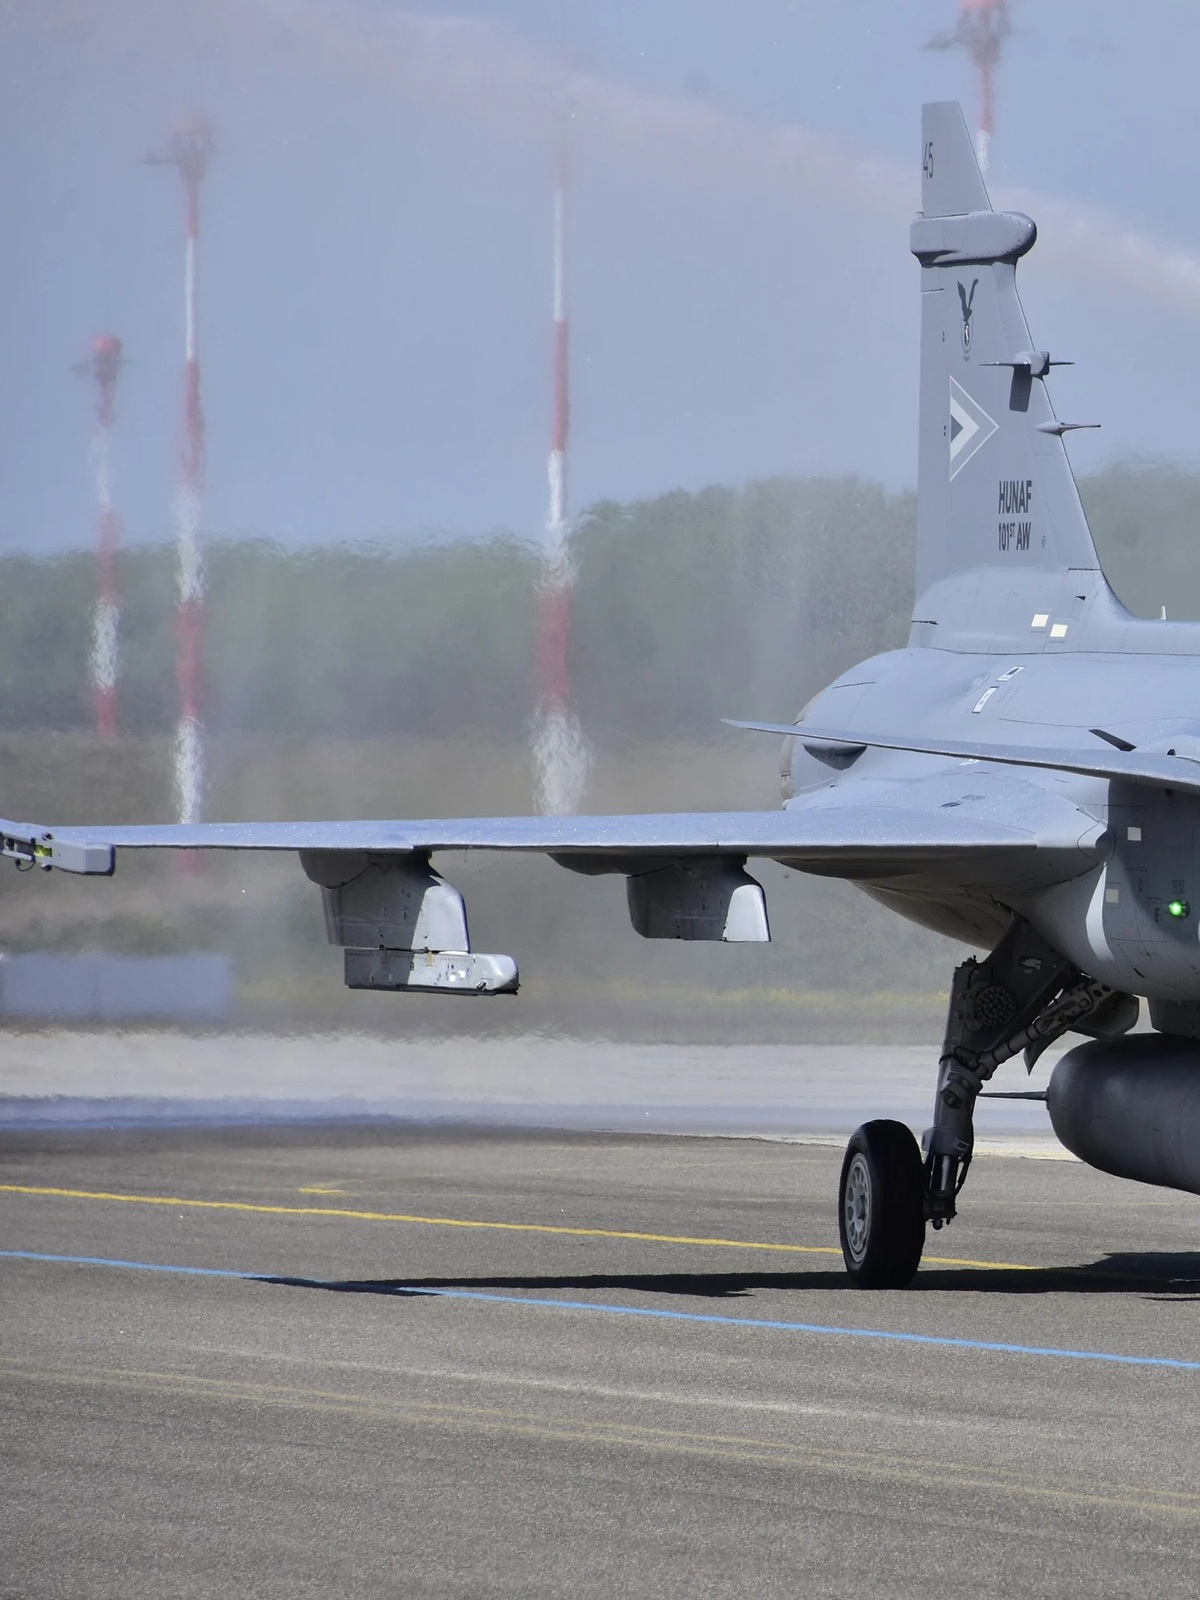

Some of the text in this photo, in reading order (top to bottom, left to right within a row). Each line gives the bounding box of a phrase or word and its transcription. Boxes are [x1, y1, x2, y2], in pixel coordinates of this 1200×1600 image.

[922, 141, 934, 179] 45
[998, 480, 1032, 515] HUNAF
[1015, 522, 1032, 551] AW
